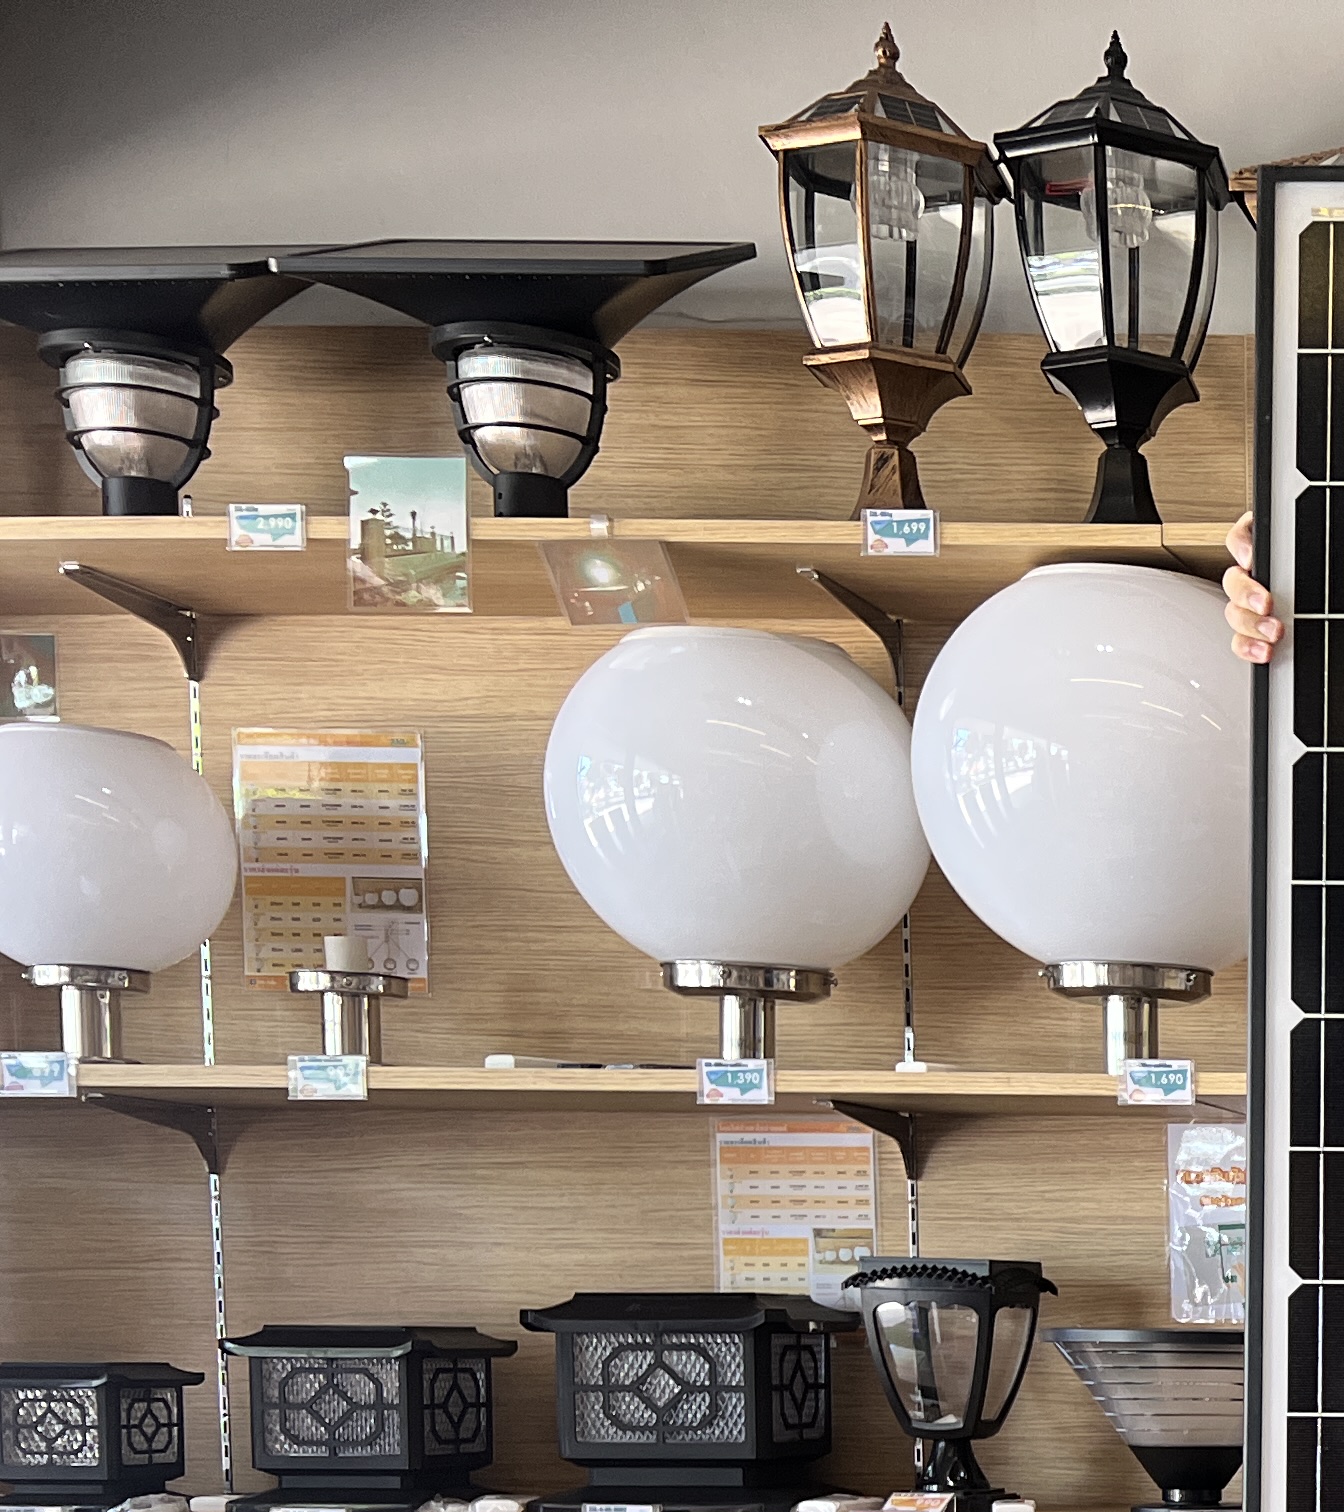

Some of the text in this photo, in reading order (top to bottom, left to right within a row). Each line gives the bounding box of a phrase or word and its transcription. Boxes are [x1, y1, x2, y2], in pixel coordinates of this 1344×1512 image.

[891, 521, 927, 535] 1,699
[726, 1070, 760, 1085] 1,390
[1150, 1072, 1184, 1086] 1,690
